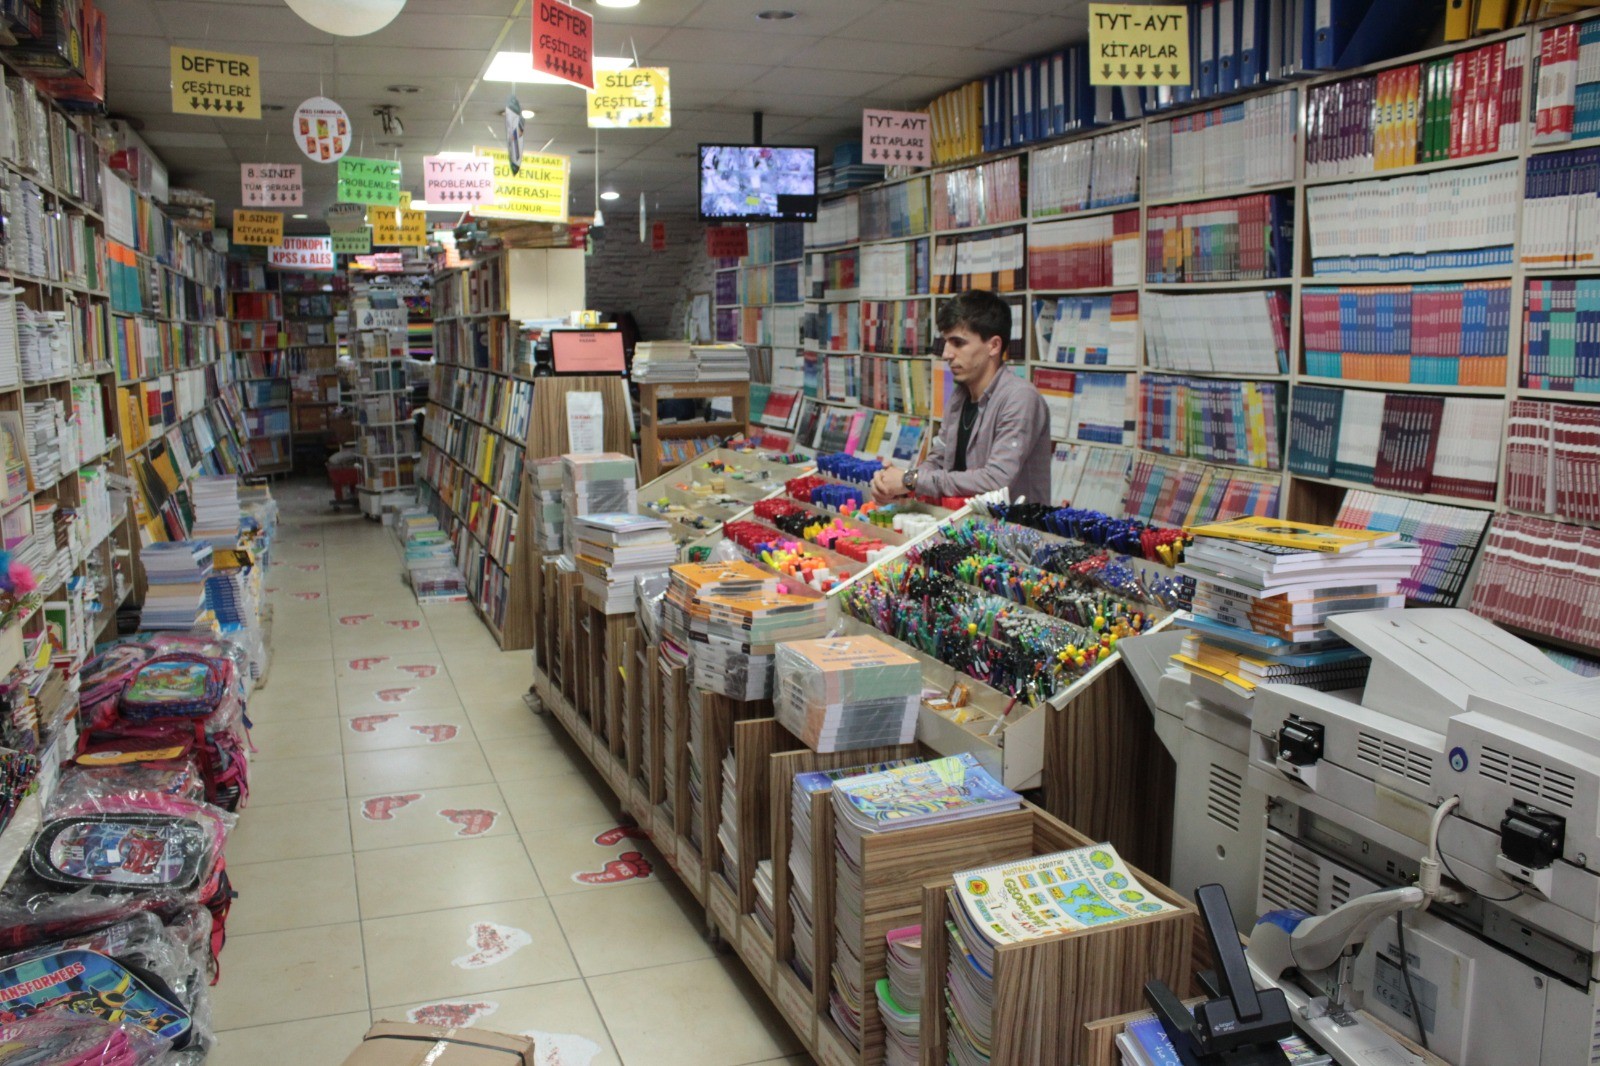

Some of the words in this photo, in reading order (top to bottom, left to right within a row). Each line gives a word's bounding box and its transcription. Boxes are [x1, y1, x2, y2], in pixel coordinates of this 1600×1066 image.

[540, 2, 587, 38] DEFTER
[1095, 13, 1182, 31] TYT-AYT
[539, 34, 588, 63] ÇEŞİTLERİ
[1101, 41, 1178, 58] KİTAPLAR
[1557, 32, 1568, 54] TYT
[181, 55, 250, 77] DEFTER
[605, 72, 652, 88] SİLGİ
[182, 80, 251, 97] ÇEŞİTLERİ
[594, 95, 664, 109] ÇEŞİTLEİ
[867, 115, 927, 130] TYT-AYT
[870, 134, 924, 147] KİTAPLARI
[342, 161, 397, 174] TYT-AYT
[429, 162, 490, 173] TYT-AYT
[493, 166, 551, 181] GÜENLİK
[428, 179, 491, 188] PROBLEMLER
[495, 186, 549, 199] AMERASI
[376, 211, 423, 221] TYTAYT
[273, 251, 298, 264] KPSS
[309, 251, 331, 265] ALES
[1002, 864, 1037, 877] AUSTRALIA
[1004, 877, 1051, 928] GEOGRAPHY
[0, 961, 86, 1003] ANSFORMERS
